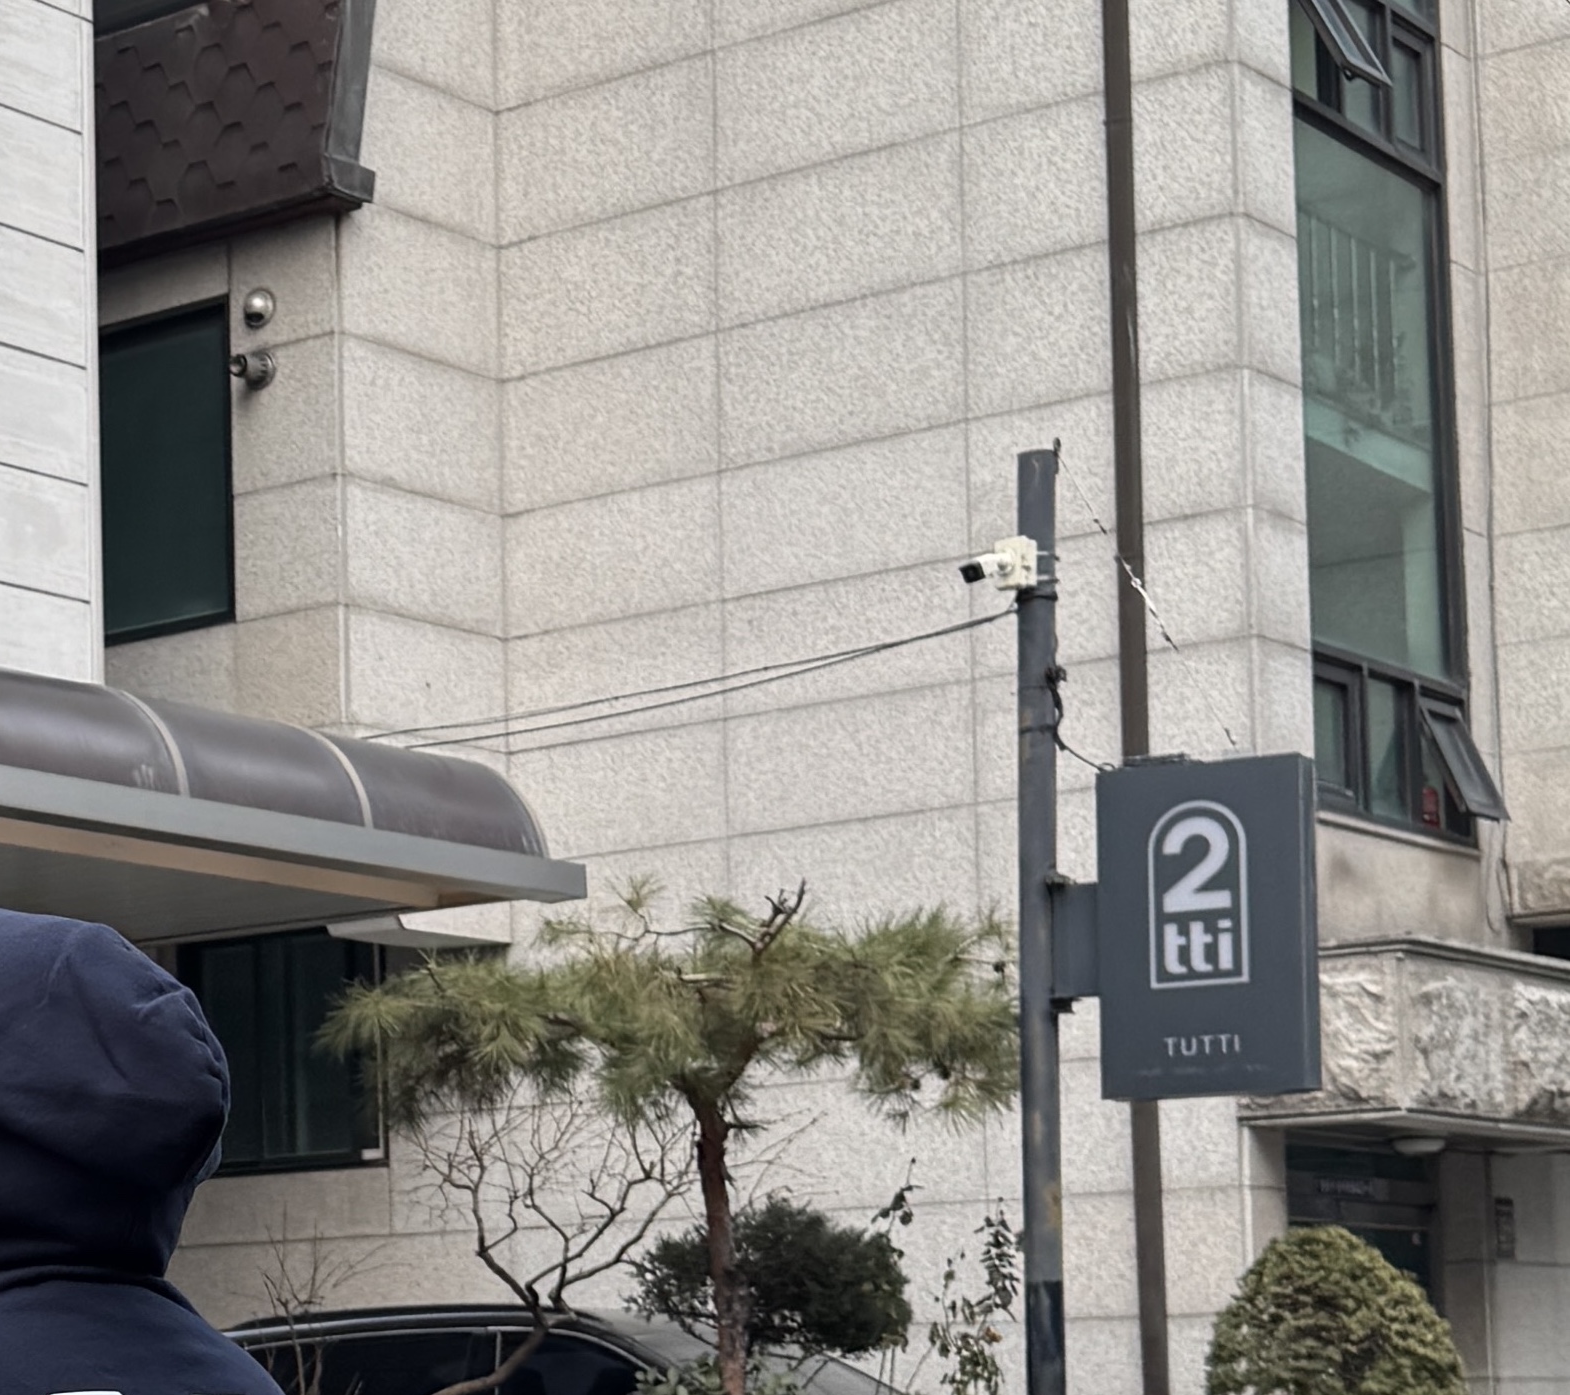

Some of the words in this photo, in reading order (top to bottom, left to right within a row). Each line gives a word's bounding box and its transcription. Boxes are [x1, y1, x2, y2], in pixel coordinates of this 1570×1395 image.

[1161, 816, 1232, 914] 2
[1163, 919, 1234, 975] tti
[1163, 1034, 1241, 1057] TUTTI
